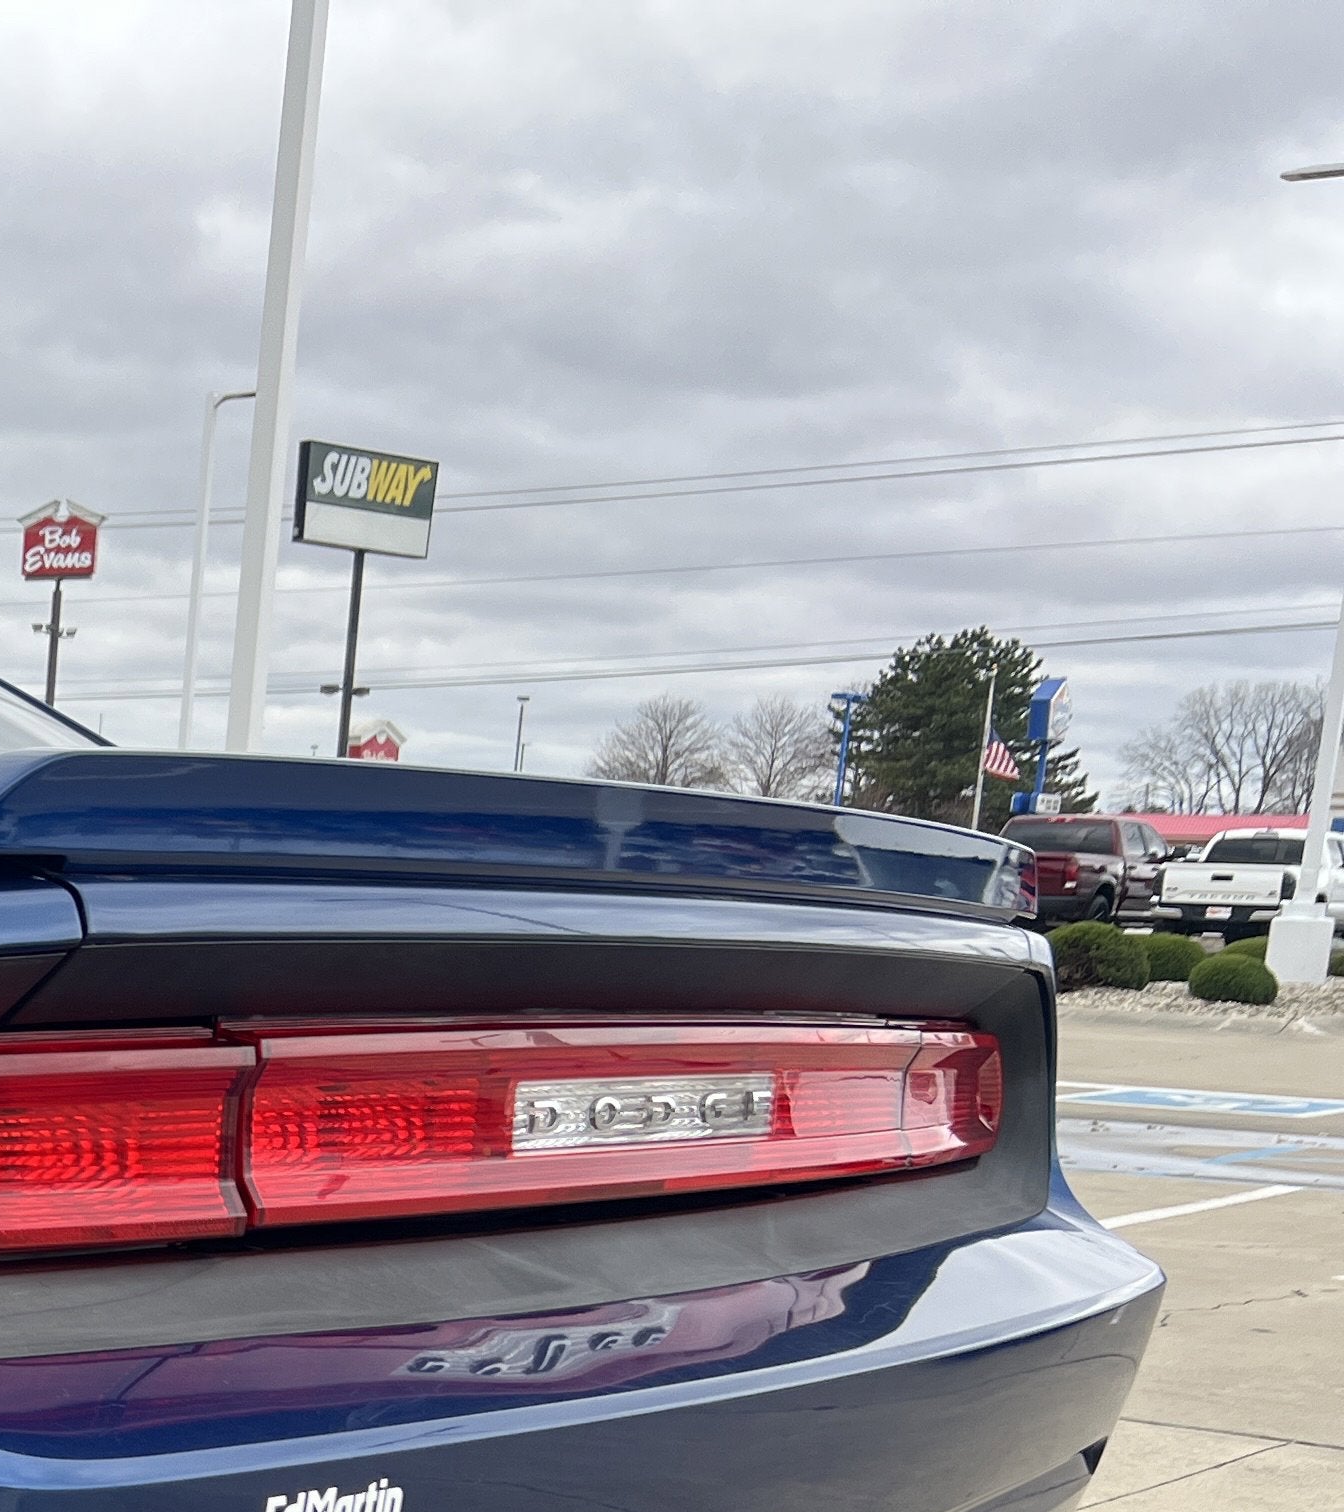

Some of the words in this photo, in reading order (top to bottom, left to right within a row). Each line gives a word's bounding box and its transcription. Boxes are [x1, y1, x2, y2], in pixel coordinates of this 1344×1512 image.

[313, 451, 432, 507] SUBWAY
[39, 526, 82, 549] Bob
[24, 545, 92, 573] Evans
